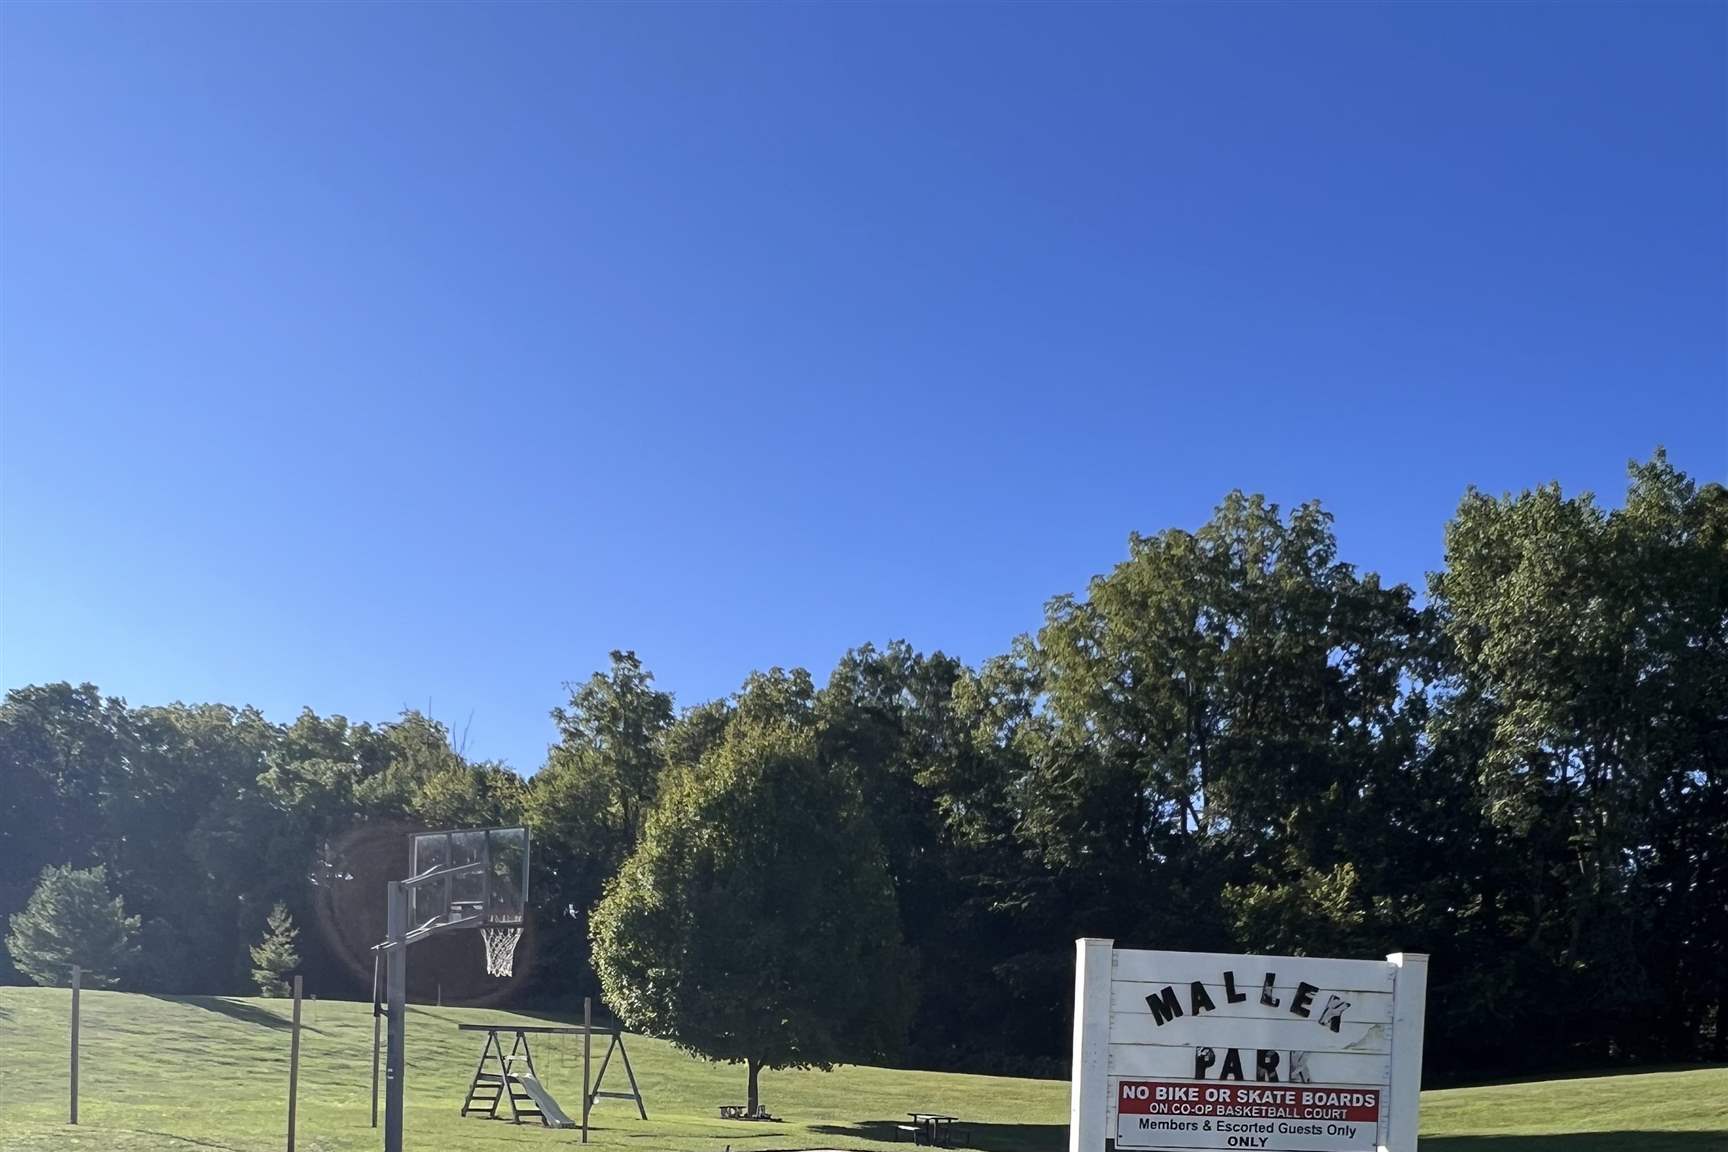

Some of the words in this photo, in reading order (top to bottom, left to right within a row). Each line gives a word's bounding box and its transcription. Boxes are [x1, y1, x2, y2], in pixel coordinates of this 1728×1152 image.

[1145, 971, 1351, 1033] MALLEK
[1195, 1046, 1311, 1083] PARK
[1123, 1086, 1150, 1100] NO
[1156, 1087, 1199, 1101] BIKE
[1205, 1089, 1231, 1103] OR
[1237, 1090, 1295, 1104] SKATE
[1302, 1092, 1376, 1107] BOARDS
[1149, 1103, 1167, 1113] ON
[1172, 1103, 1212, 1115] CO-OP
[1216, 1105, 1300, 1118] BASKETBALL
[1304, 1108, 1347, 1119] COURT
[1139, 1118, 1198, 1131] Members
[1203, 1120, 1211, 1130] &
[1216, 1120, 1274, 1133] Escorted
[1279, 1122, 1323, 1135] Guests
[1327, 1124, 1356, 1138] Only
[1227, 1136, 1268, 1147] ONLY
